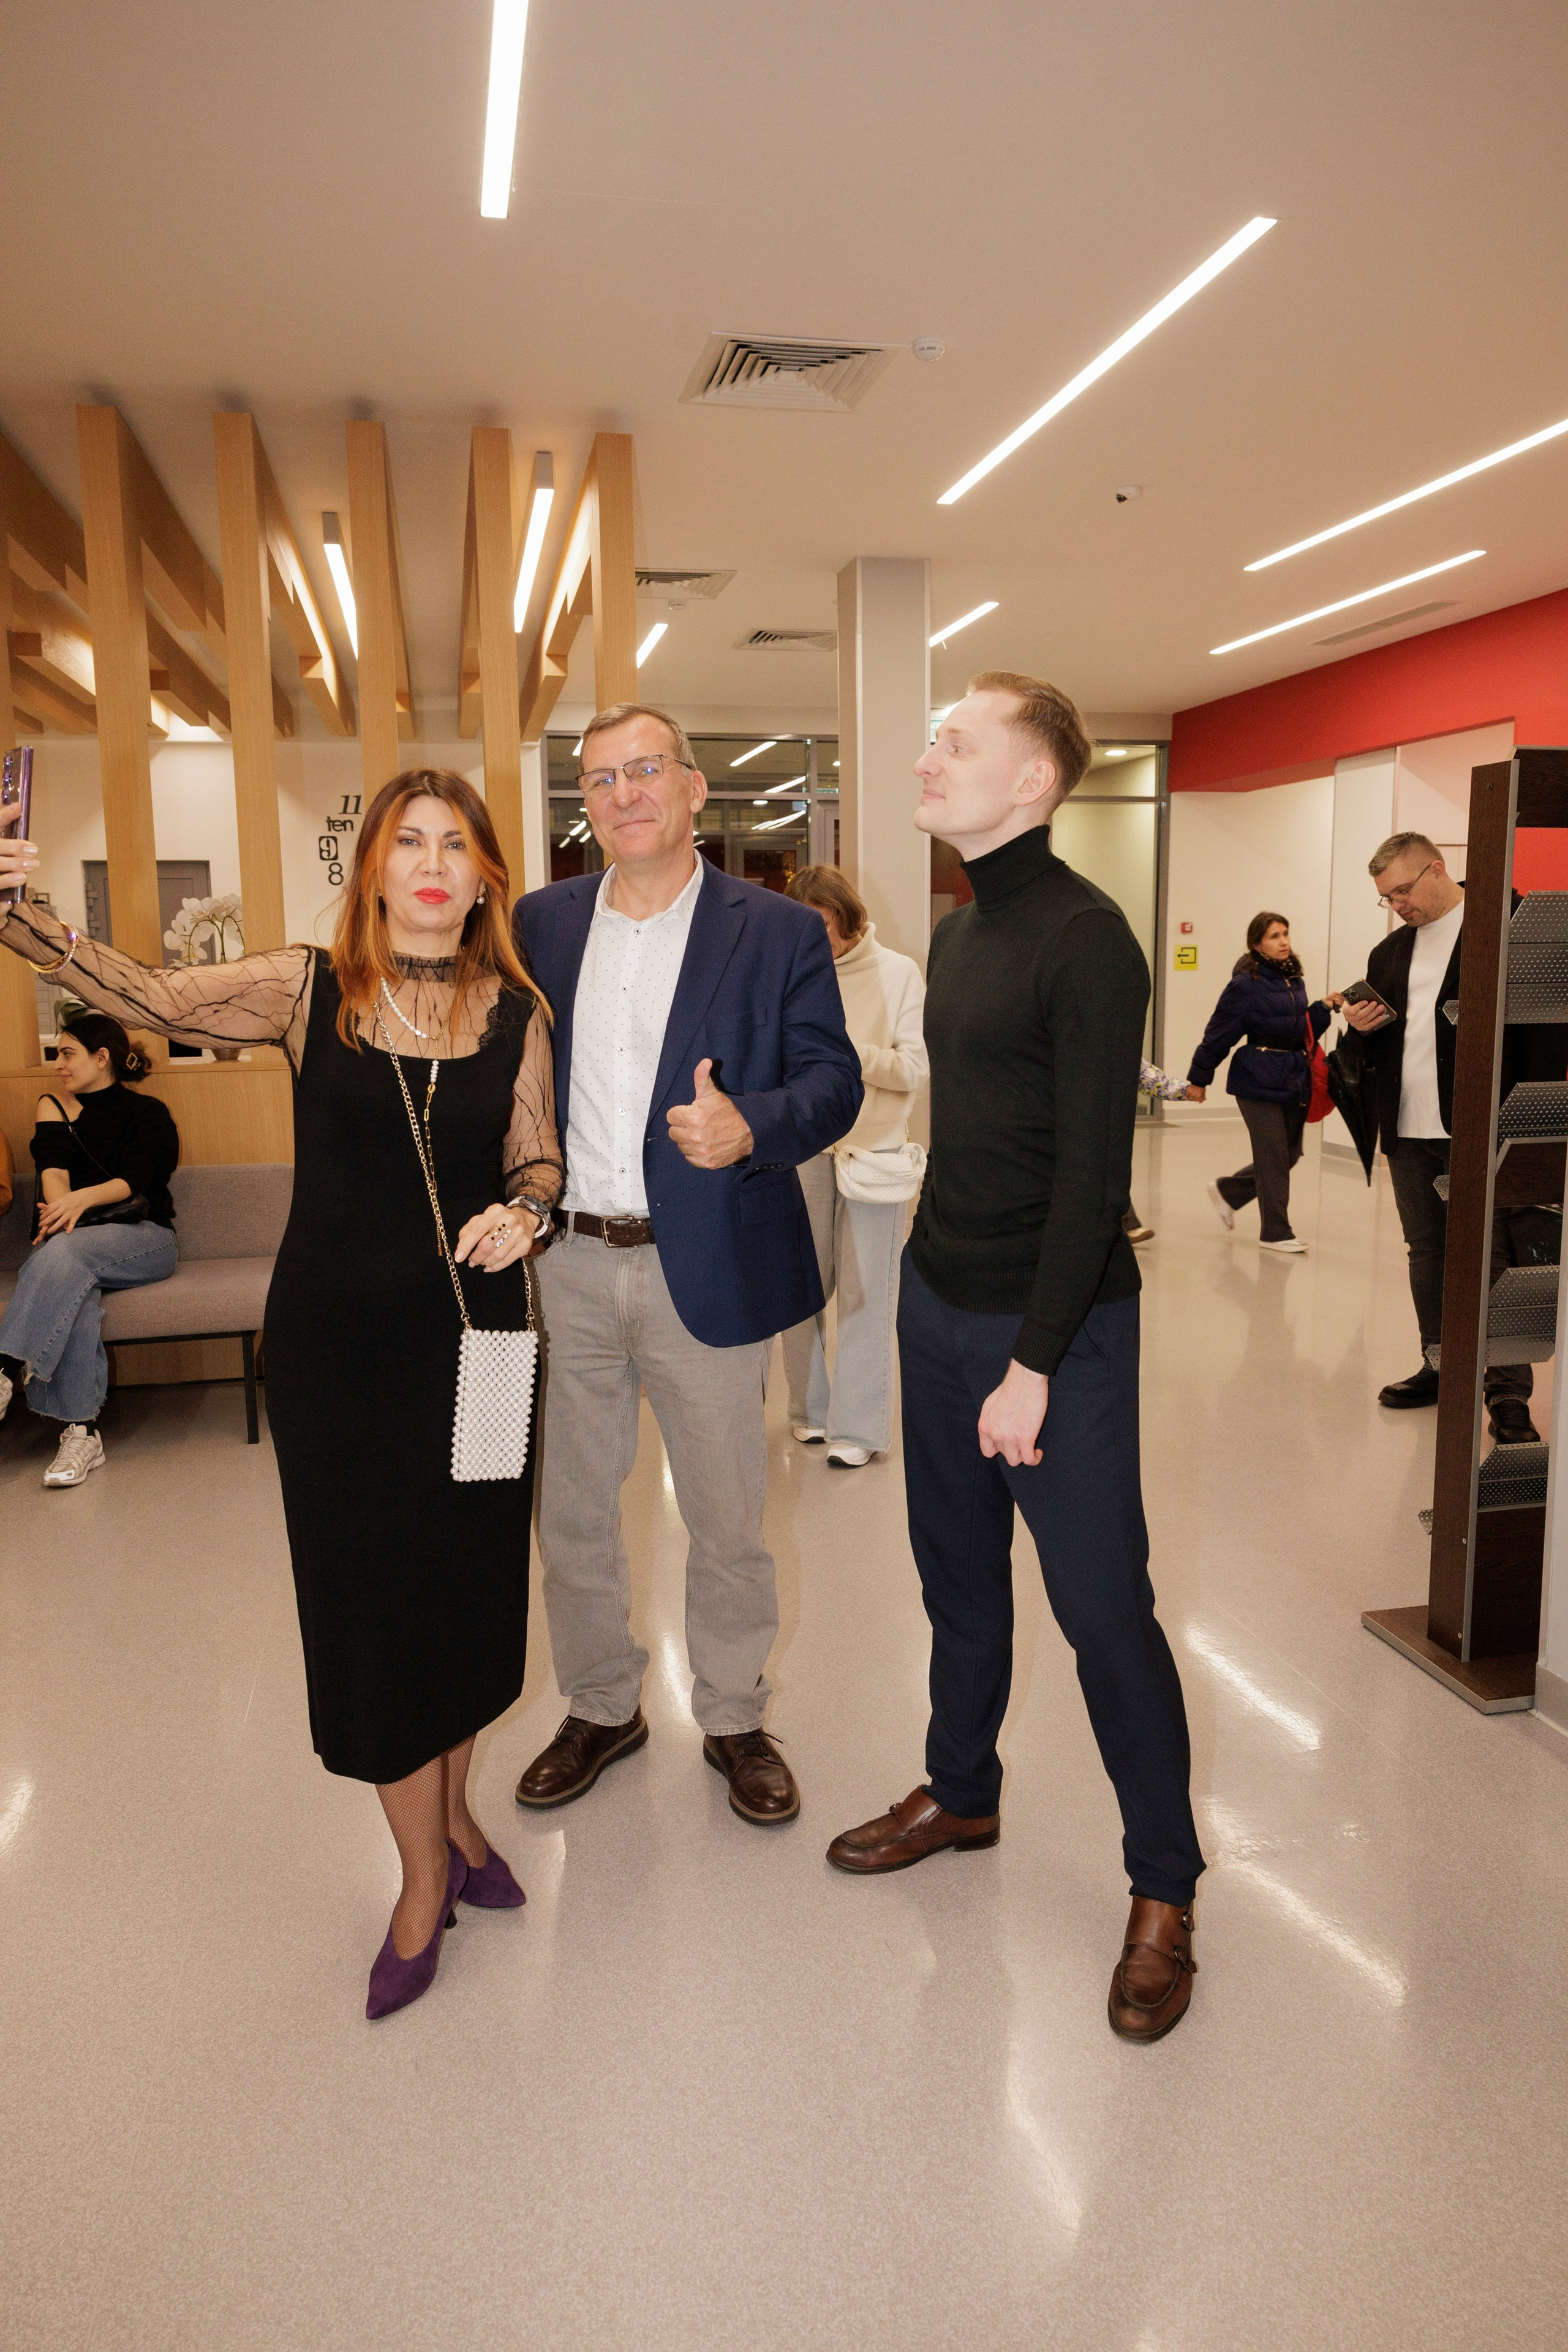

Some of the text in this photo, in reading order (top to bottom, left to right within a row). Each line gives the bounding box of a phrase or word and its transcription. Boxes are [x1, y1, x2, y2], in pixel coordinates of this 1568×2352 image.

[338, 794, 362, 815] 11
[326, 816, 354, 832] ten
[318, 835, 339, 861] 9
[328, 862, 344, 886] 8
